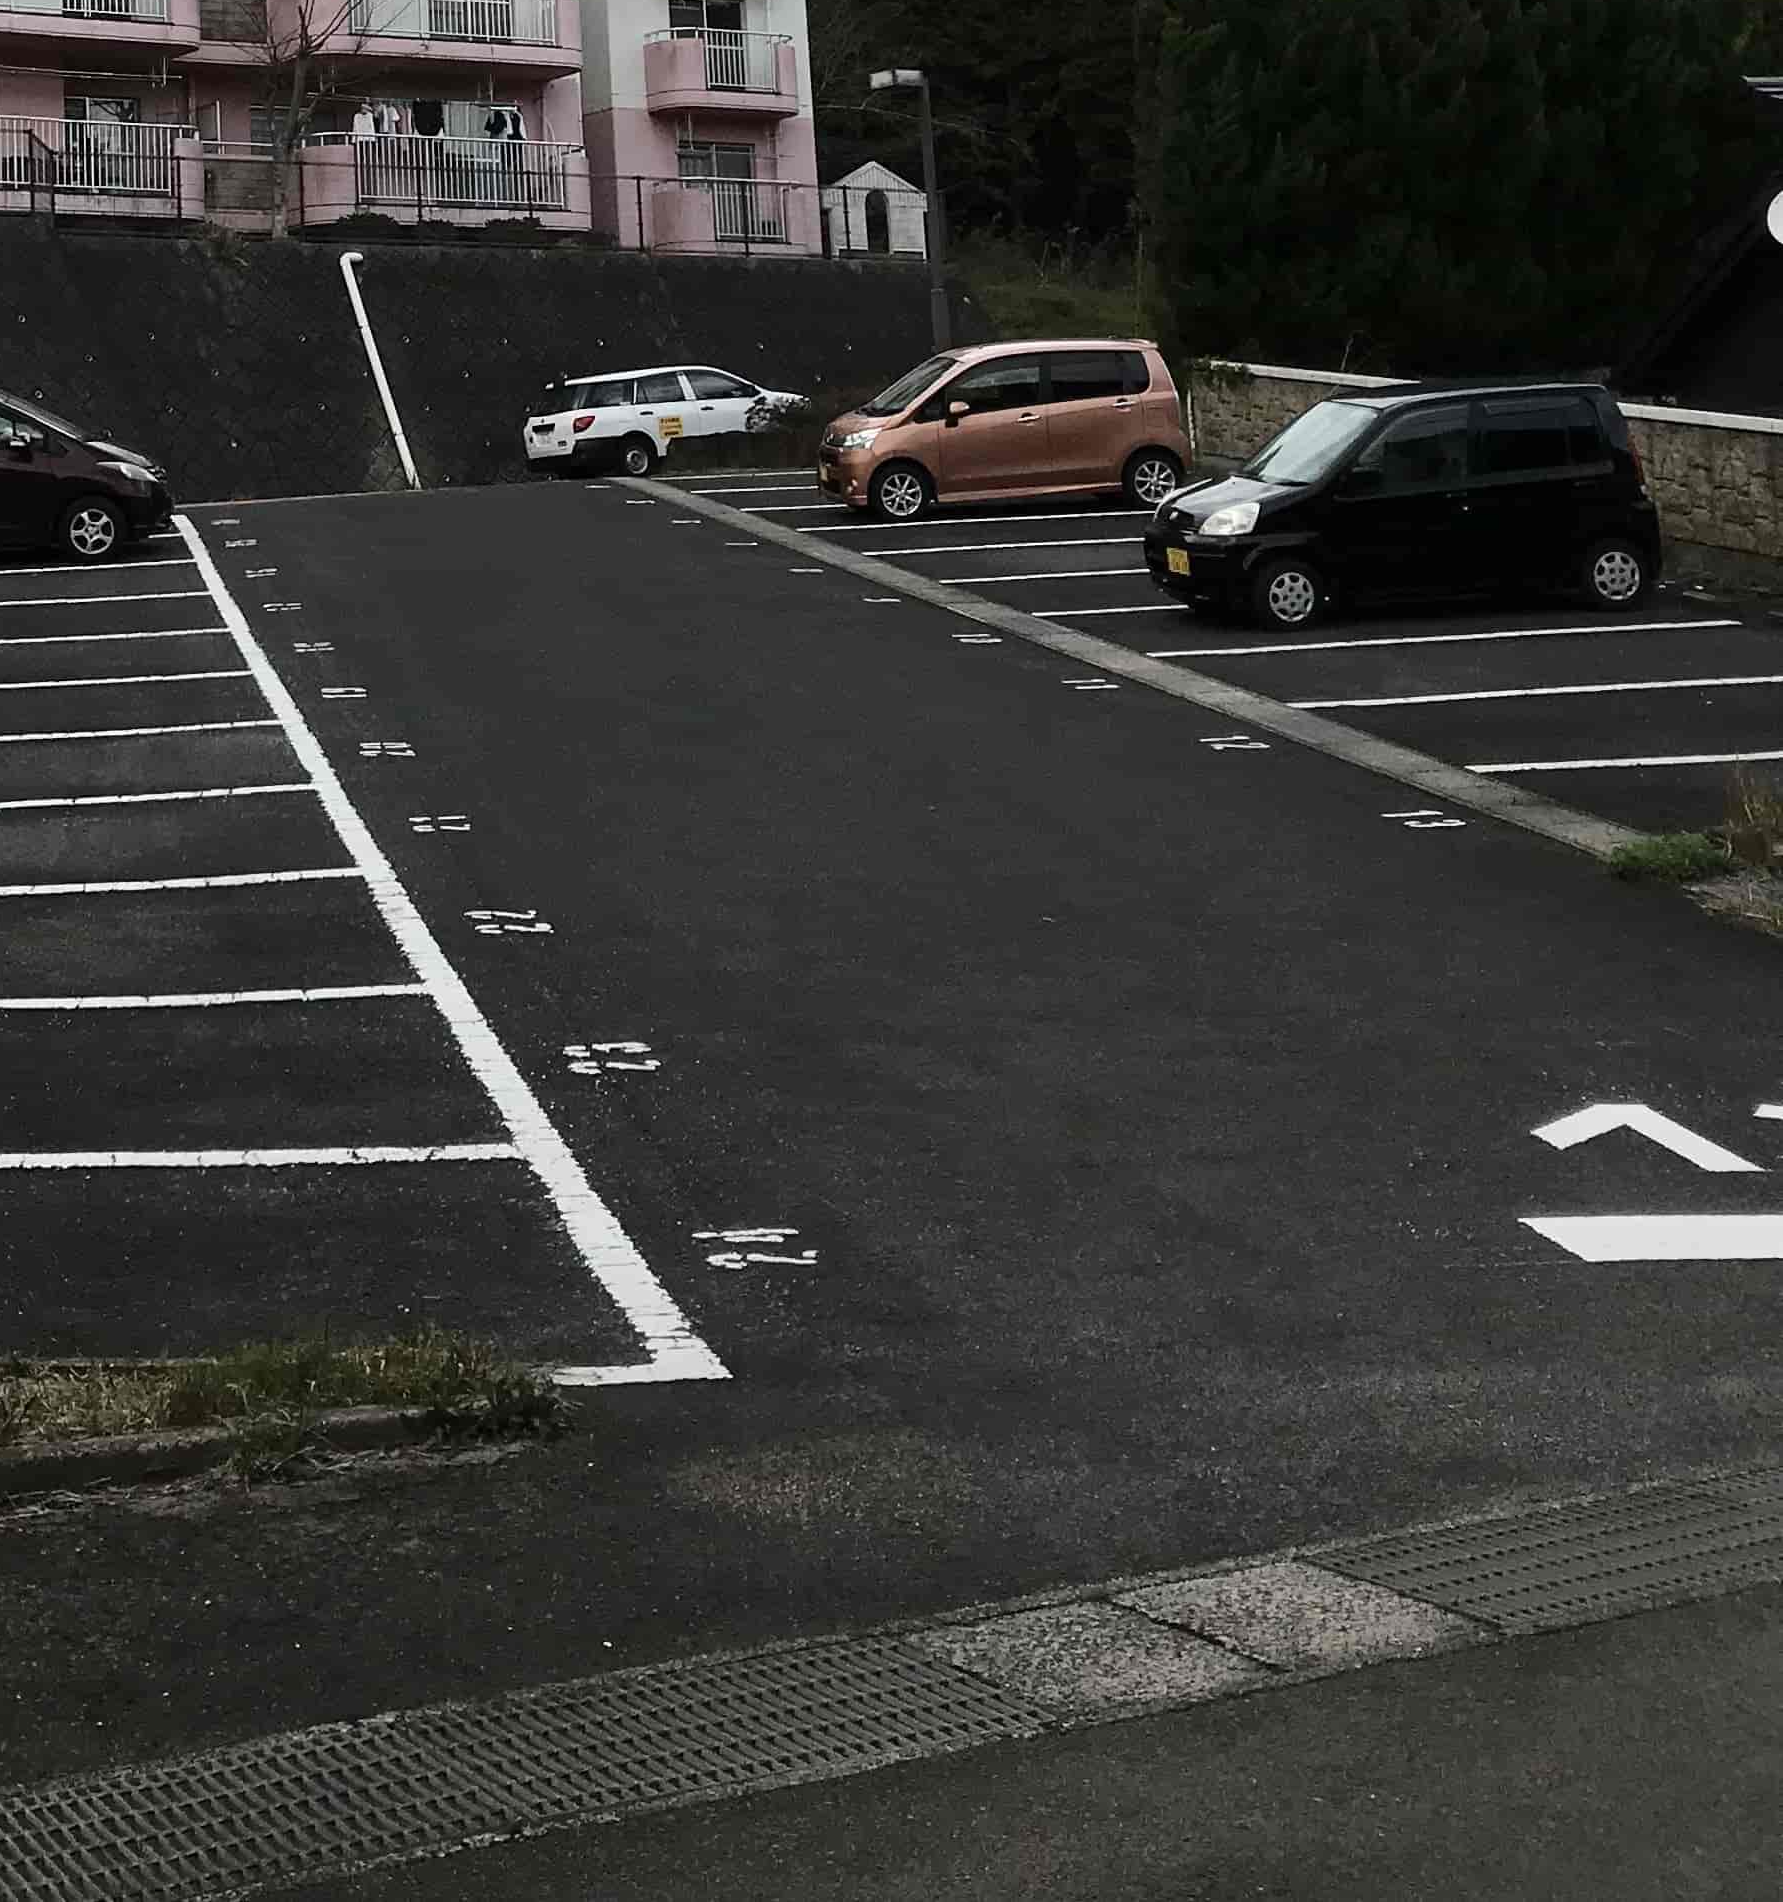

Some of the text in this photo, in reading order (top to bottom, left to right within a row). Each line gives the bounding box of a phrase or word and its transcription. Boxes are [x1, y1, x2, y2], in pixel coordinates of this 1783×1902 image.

[1199, 734, 1271, 751] 12
[1380, 809, 1468, 828] 13
[463, 909, 554, 935] 22
[562, 1041, 663, 1076] 23
[690, 1226, 818, 1271] 24
